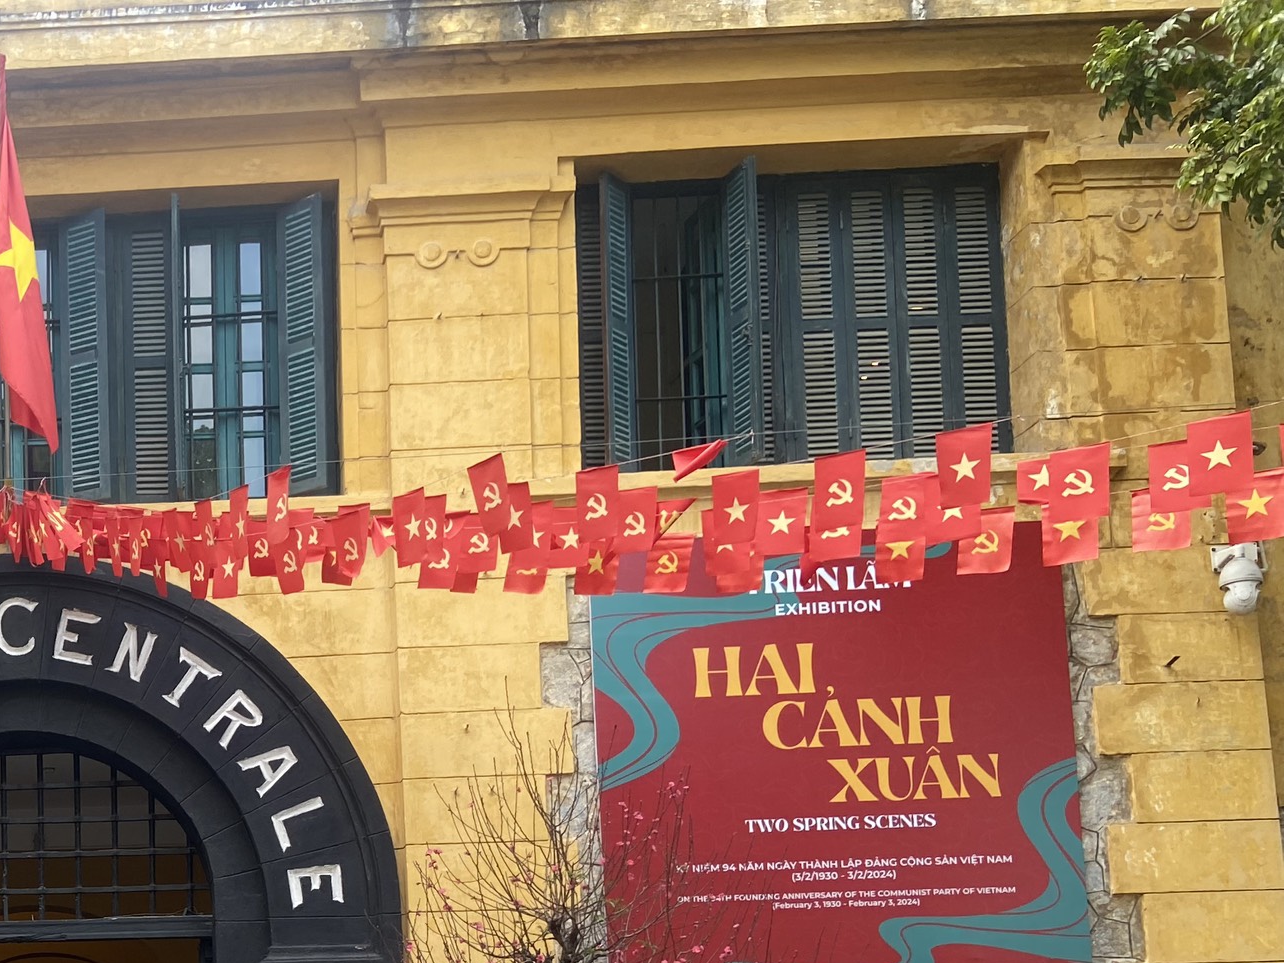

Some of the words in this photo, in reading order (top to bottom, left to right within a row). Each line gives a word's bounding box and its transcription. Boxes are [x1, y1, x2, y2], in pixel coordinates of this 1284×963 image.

[749, 566, 839, 595] RIN
[846, 560, 913, 591] LÃ
[775, 599, 881, 616] EXHIBITION
[692, 642, 816, 698] HAI
[762, 685, 954, 750] CẢNH
[826, 745, 1002, 803] XUÂN
[745, 818, 789, 833] TWO
[792, 816, 860, 832] SPRING
[863, 813, 937, 830] SCENES
[722, 863, 737, 872] 94
[739, 860, 764, 872] NĂM
[767, 858, 797, 871] NGÀY
[799, 857, 839, 870] THÀNH
[841, 857, 862, 871] LẬP
[865, 855, 897, 868] ĐẢNG
[899, 855, 933, 869] CỘNG
[935, 853, 958, 867] SẢN
[959, 853, 985, 867] VIỆT
[987, 854, 1013, 864] NAM
[791, 870, 838, 882] (3/2/1930
[847, 869, 897, 881] 3/2/2024)
[782, 890, 843, 900] ANNIVERSARY
[845, 890, 857, 898] OF
[859, 889, 876, 898] THE
[878, 888, 931, 897] COMMUNIST
[933, 887, 960, 896] PARTY
[962, 886, 975, 895] OF
[977, 885, 1016, 894] VIETNAM
[772, 901, 813, 911] (February
[814, 901, 822, 909] 3,
[823, 900, 841, 908] 1930
[848, 899, 886, 910] February
[888, 899, 896, 907] 3,
[897, 898, 920, 907] 2024)
